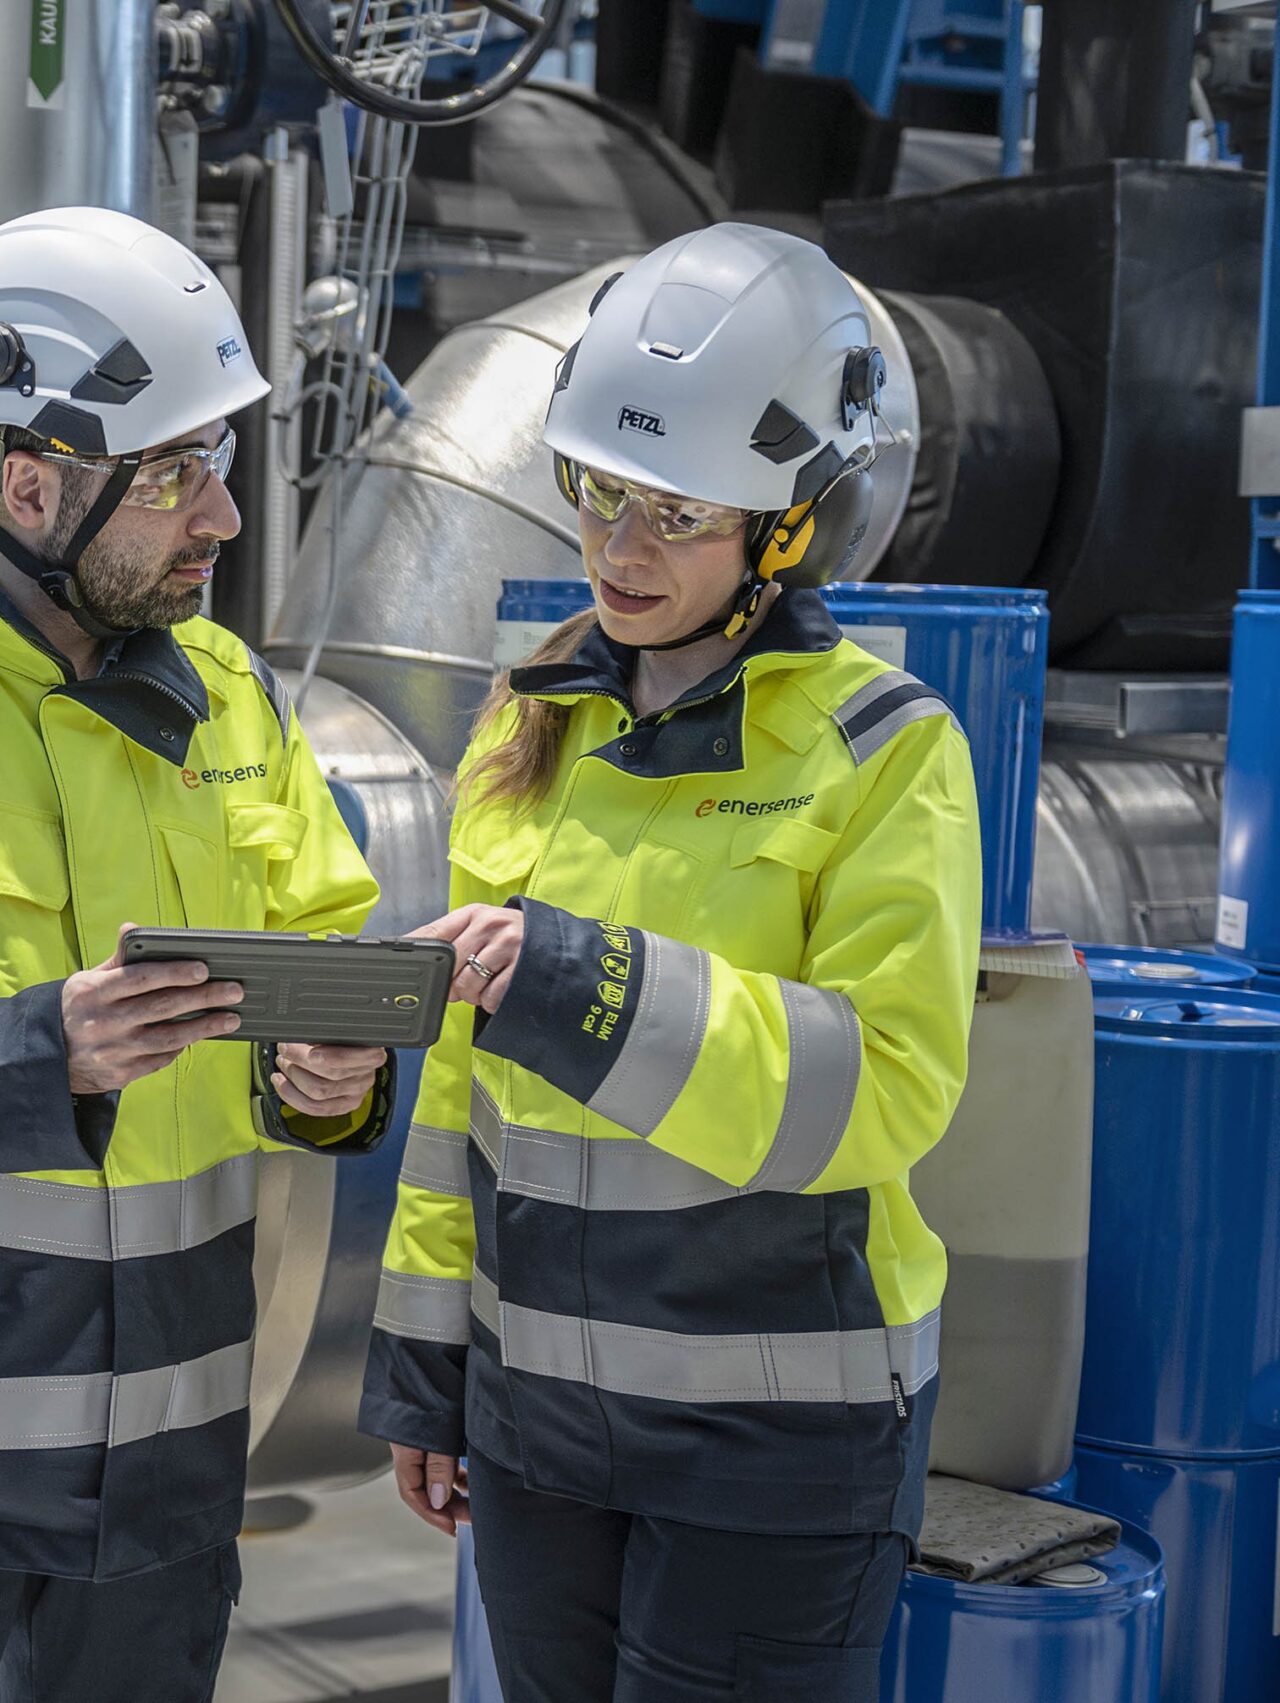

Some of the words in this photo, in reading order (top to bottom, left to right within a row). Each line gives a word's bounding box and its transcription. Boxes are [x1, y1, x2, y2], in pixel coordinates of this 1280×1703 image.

[39, 0, 58, 45] KAU
[216, 339, 241, 368] PETZL
[618, 408, 667, 436] PETZL
[201, 763, 267, 784] enrsens
[718, 793, 815, 816] enersense
[581, 1014, 596, 1033] cal
[590, 1004, 602, 1015] 9
[596, 1011, 619, 1041] ELIM
[892, 1380, 907, 1417] FRISTADS
